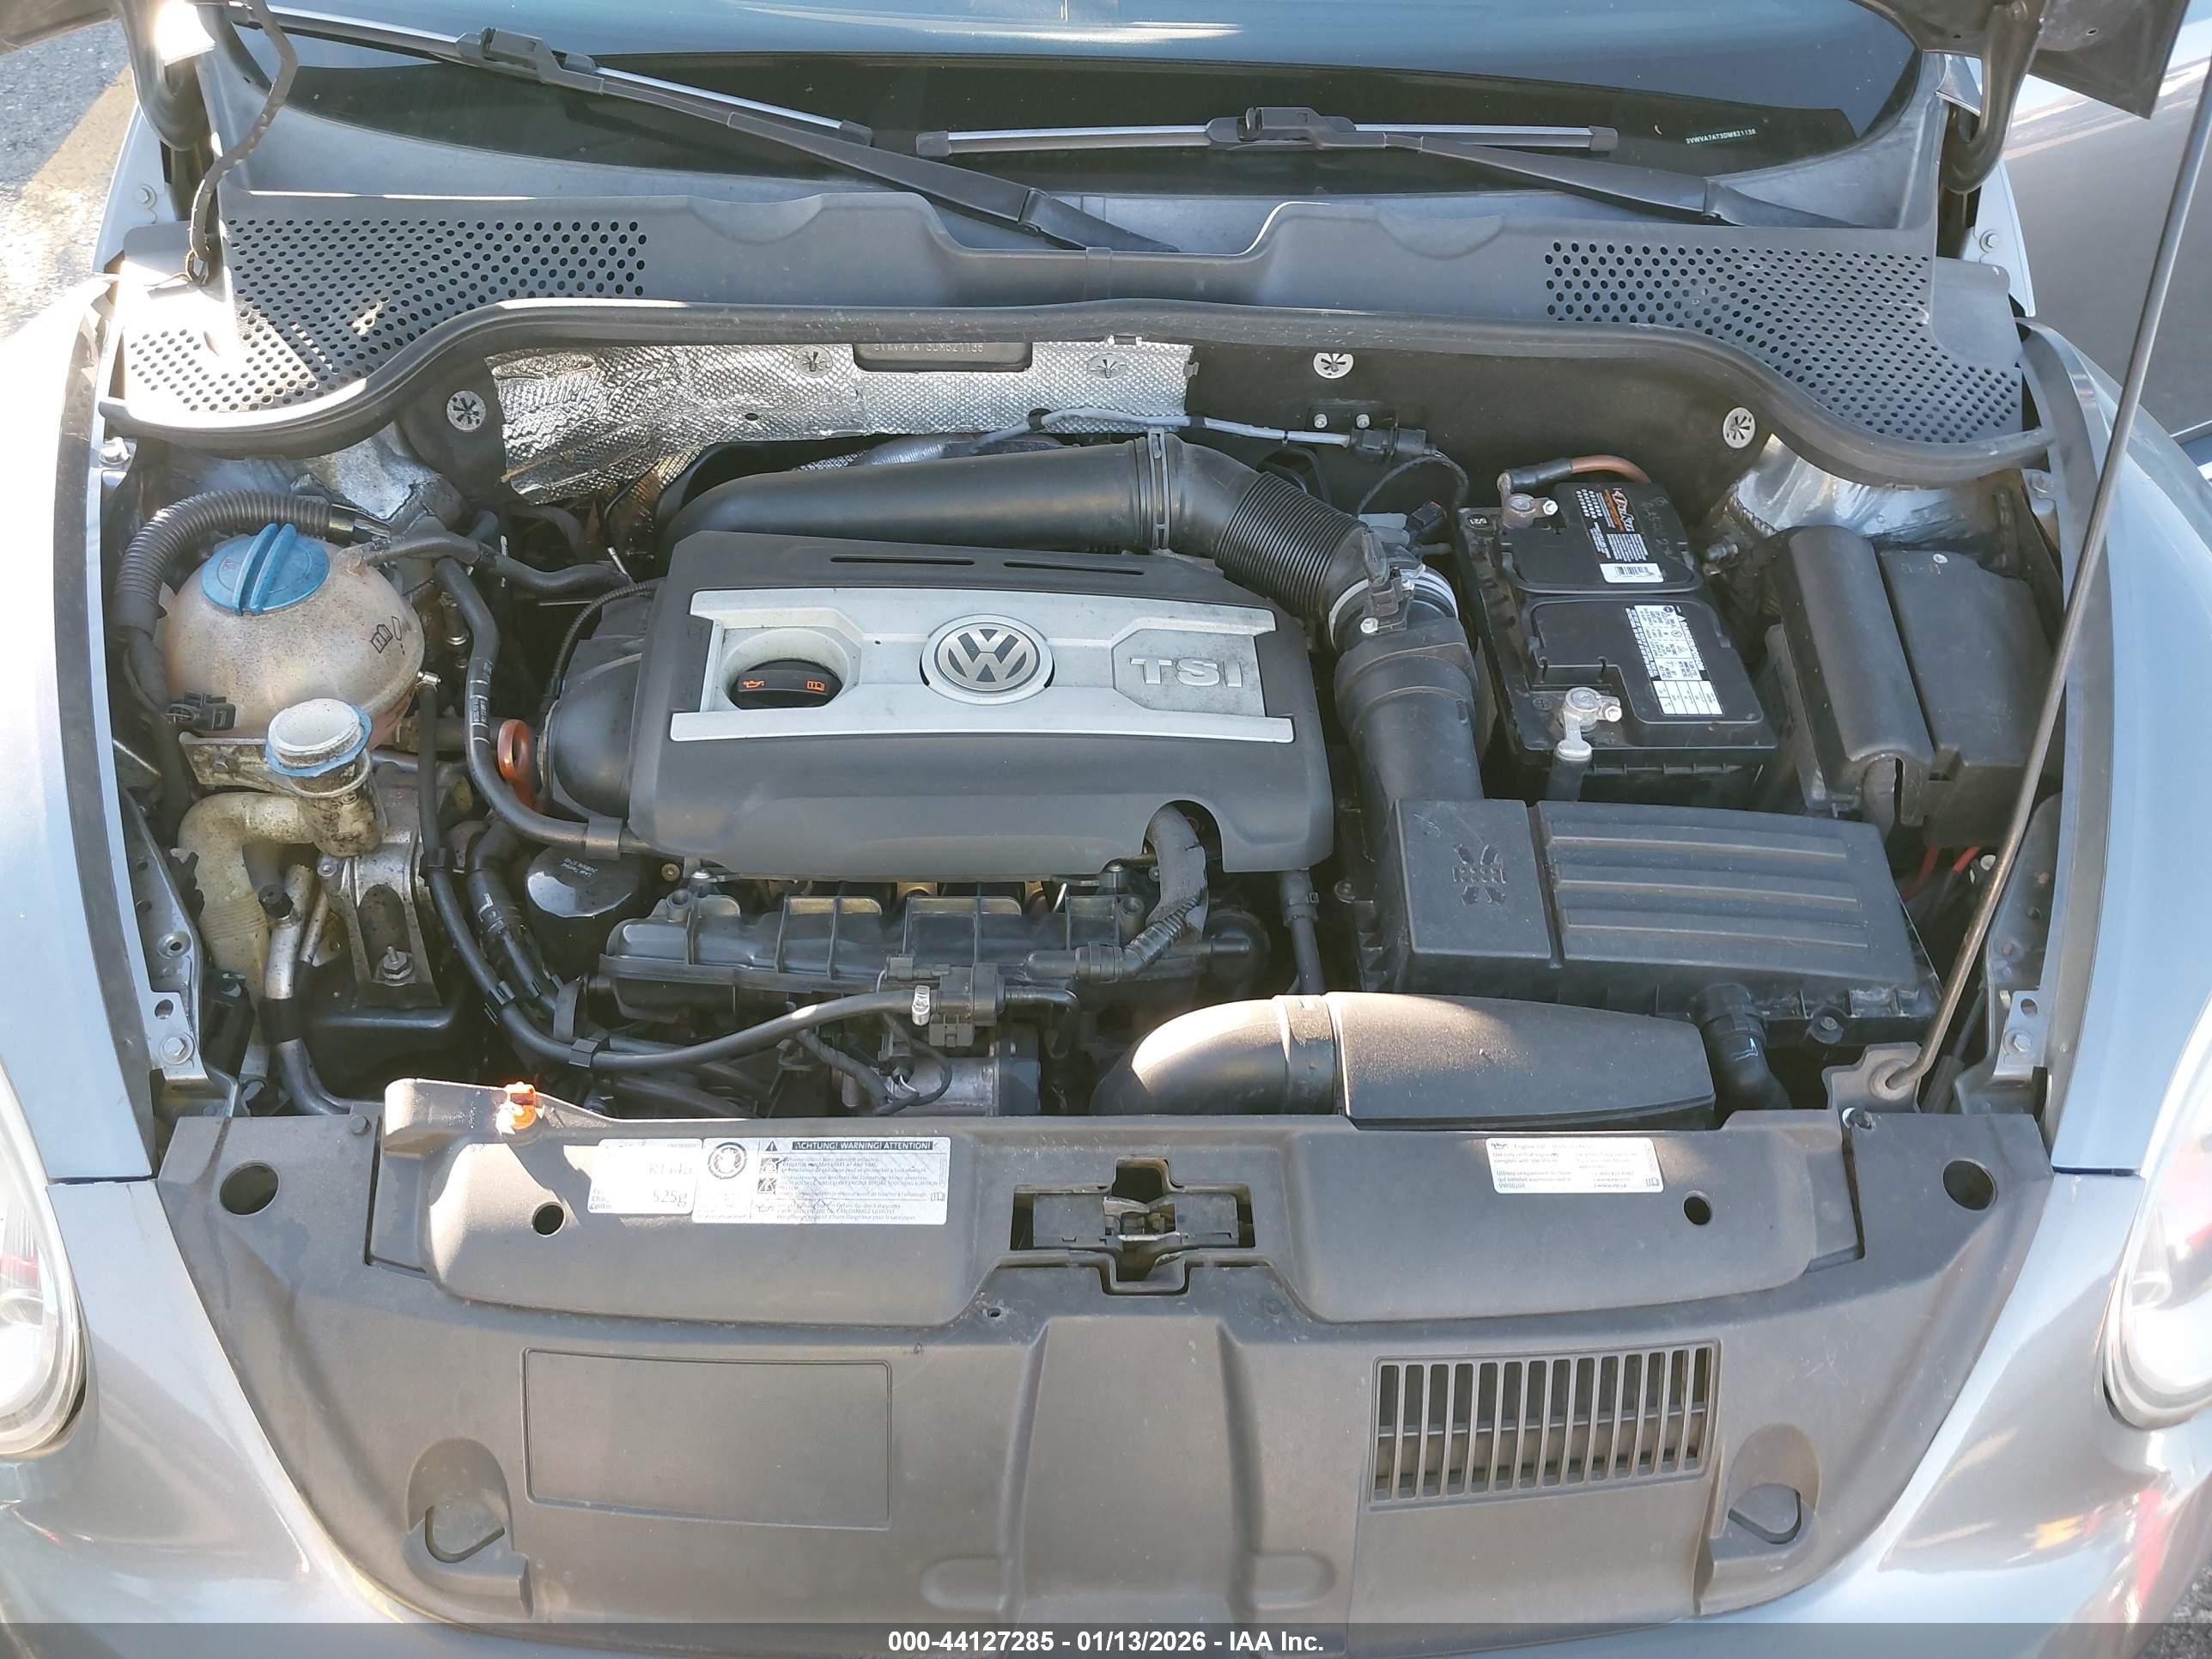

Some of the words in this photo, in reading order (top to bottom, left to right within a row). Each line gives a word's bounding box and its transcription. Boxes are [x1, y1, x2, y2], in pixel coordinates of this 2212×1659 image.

[1129, 656, 1243, 688] TSI
[795, 1141, 838, 1150] ACHTUNG!
[841, 1141, 883, 1150] WARNING!
[884, 1141, 931, 1150] ATTENTION!
